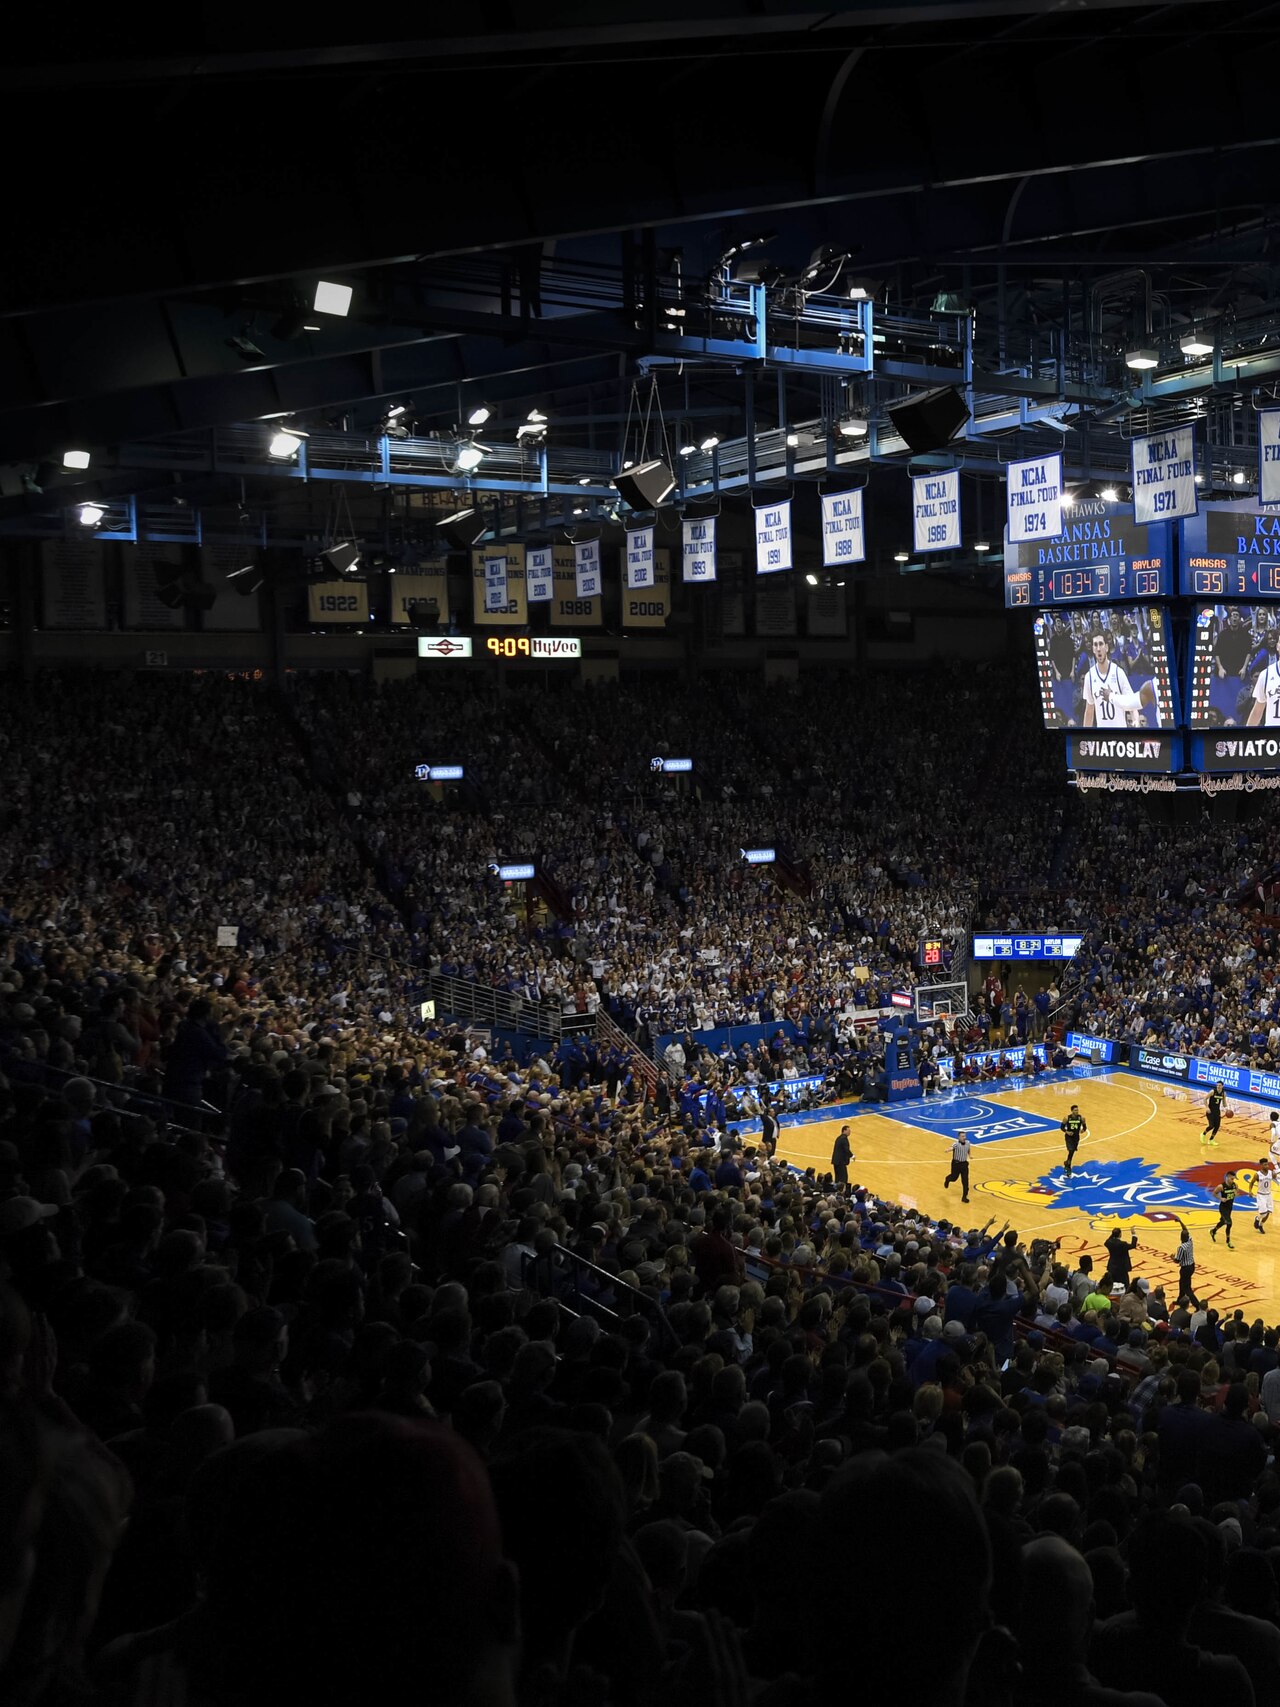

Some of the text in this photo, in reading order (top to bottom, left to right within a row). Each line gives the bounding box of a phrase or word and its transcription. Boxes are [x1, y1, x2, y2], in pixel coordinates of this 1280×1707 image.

[1148, 439, 1177, 463] NCAA
[1021, 466, 1046, 487] NCAA
[1136, 460, 1191, 485] FINAL FOUR
[925, 481, 946, 500] NCAA
[1010, 486, 1058, 507] FINAL FOUR
[832, 499, 852, 517] NCAA
[916, 499, 956, 518] FINAL FOUR
[1154, 490, 1176, 512] 1971
[765, 511, 782, 527] NCAA
[825, 516, 860, 534] FINAL FOUR
[1024, 512, 1046, 533] 1974
[691, 525, 706, 540] NCAA
[758, 531, 774, 544] FINAL
[927, 524, 947, 543] 1986
[633, 535, 647, 549] NCAA
[684, 543, 699, 555] FINAL
[835, 539, 852, 557] 1988
[581, 547, 593, 560] NCAA
[767, 549, 780, 565] 1991
[1038, 539, 1126, 565] BASKETBALL
[692, 561, 706, 575] 1993
[1132, 559, 1161, 570] BAYLOR
[1189, 558, 1227, 568] KANSAS
[1007, 572, 1032, 583] KANSAS
[1061, 573, 1092, 595] 18:34
[1098, 576, 1105, 593] 2
[1142, 574, 1157, 593] 36
[1202, 573, 1221, 592] 35
[1238, 576, 1245, 592] 3
[1039, 586, 1045, 601] 3
[1120, 578, 1126, 594] 2
[320, 596, 357, 611] 1922
[1015, 587, 1027, 604] 35
[559, 600, 592, 615] 1988
[629, 601, 664, 616] 2008
[487, 638, 530, 656] 9:09
[533, 640, 577, 655] HyVee
[1100, 701, 1115, 721] 10
[1079, 739, 1162, 759] SVIATOSLAV
[1198, 771, 1244, 798] Russell
[925, 949, 940, 963] 28
[1082, 1038, 1107, 1052] SHELTER
[1138, 1050, 1161, 1066] EZcase
[1208, 1065, 1240, 1080] SHELTER
[1208, 1075, 1238, 1088] INSURANCE
[1215, 1271, 1265, 1292] Allen
